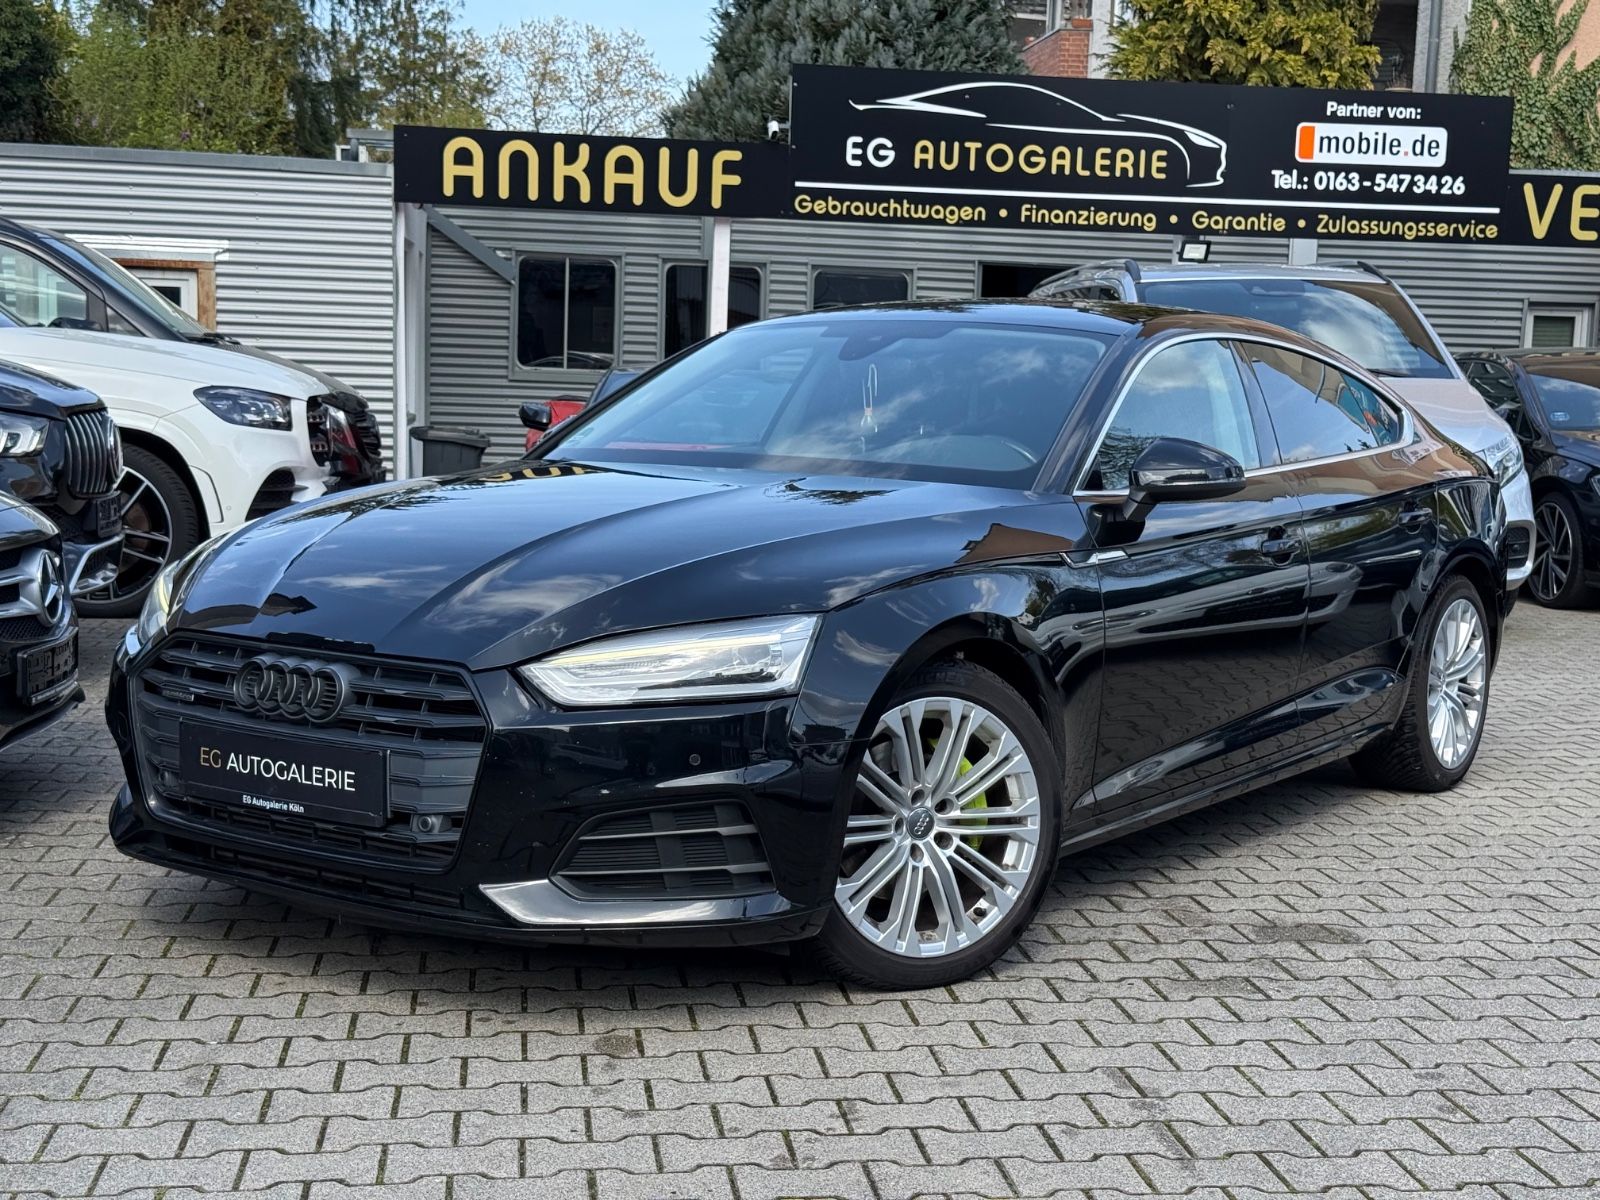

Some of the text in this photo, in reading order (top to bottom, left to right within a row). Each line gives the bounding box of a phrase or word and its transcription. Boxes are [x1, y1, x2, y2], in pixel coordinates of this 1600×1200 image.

[1326, 101, 1421, 119] Partner von:
[845, 136, 1168, 179] EG AUTOGALERIE
[1318, 132, 1440, 157] mobile.de
[442, 136, 742, 209] ANKAUF
[1271, 170, 1308, 190] Tel.:
[794, 195, 1499, 240] Gebrauchtwagen Finanzierung Garantie Zulassungsservice
[200, 747, 356, 792] EG AUTOGALERIE
[242, 794, 305, 813] EG Autogalerie Köln
